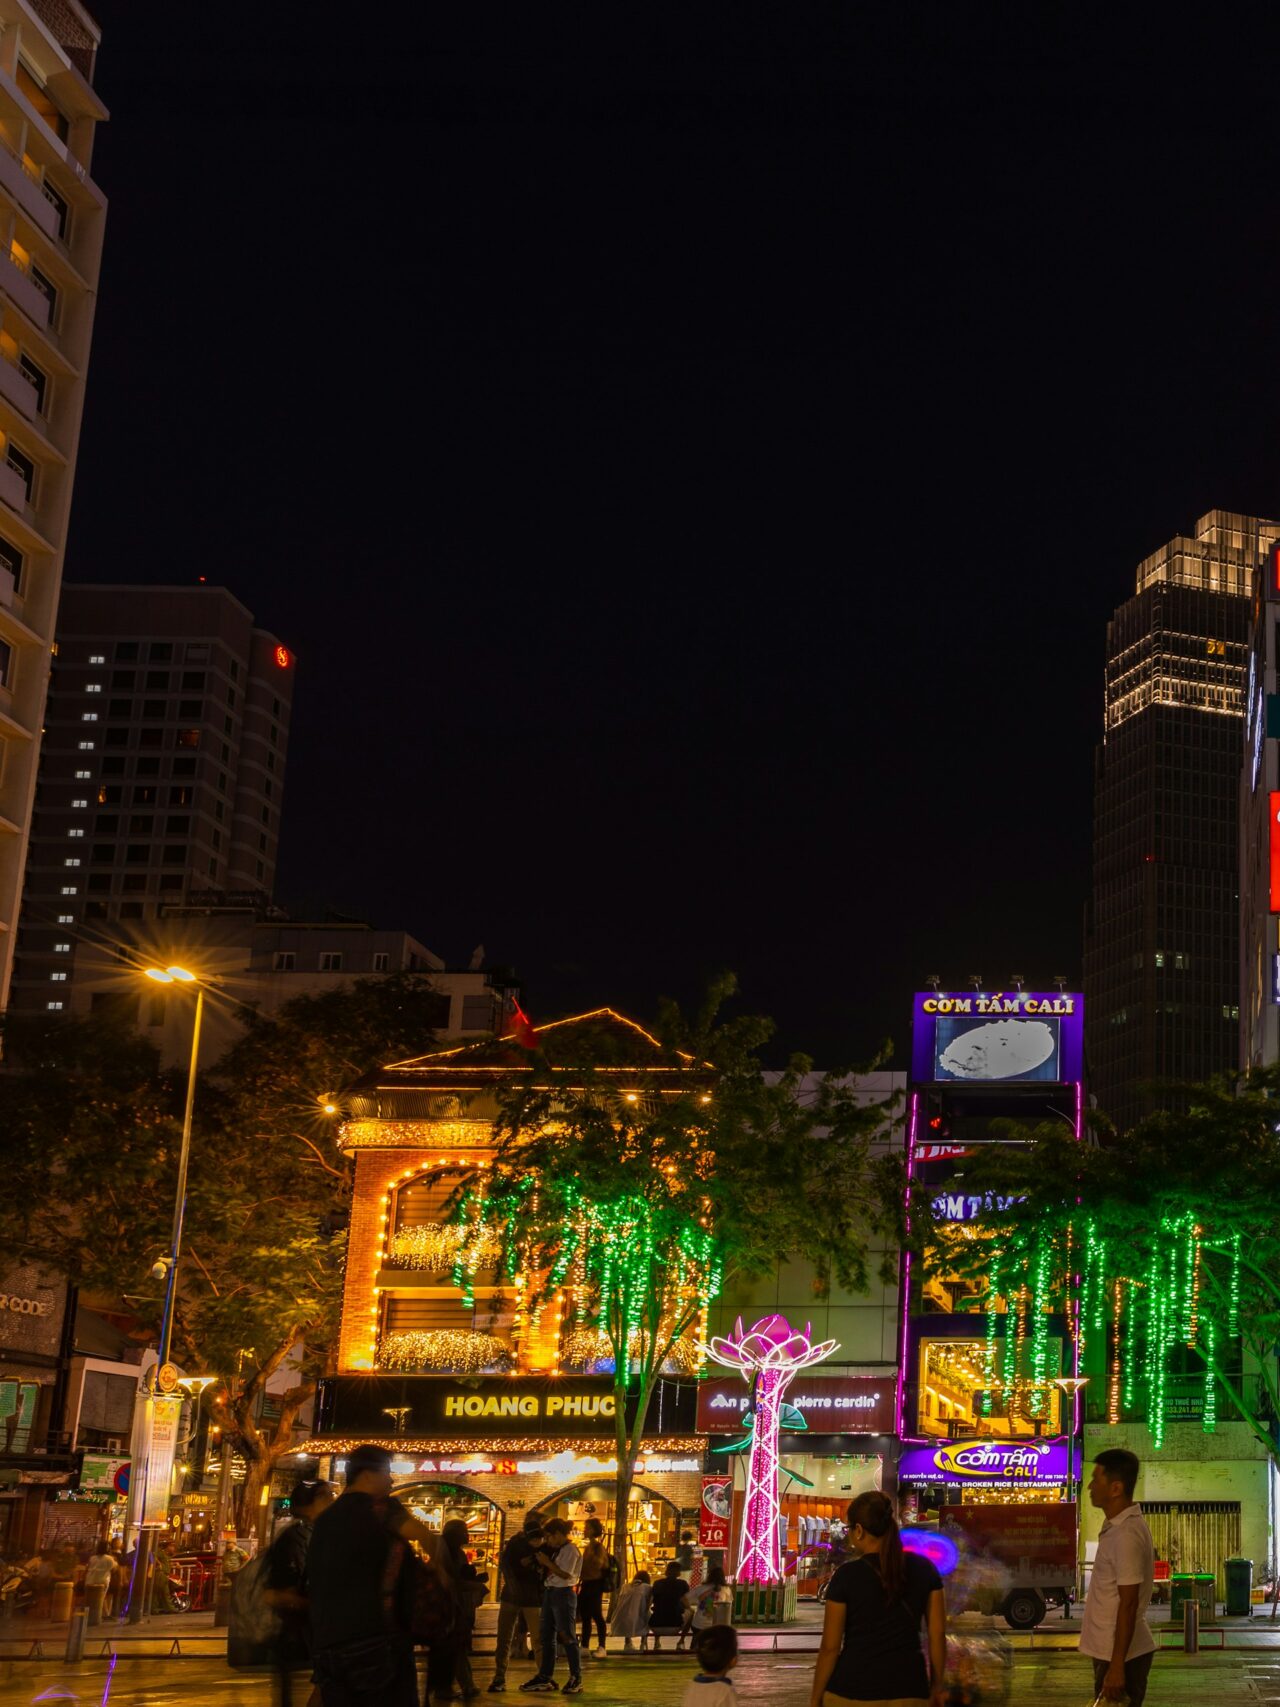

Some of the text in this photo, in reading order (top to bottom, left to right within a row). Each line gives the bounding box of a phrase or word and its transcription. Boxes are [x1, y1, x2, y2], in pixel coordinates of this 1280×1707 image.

[923, 993, 1075, 1014] CƠM TẤM CALI
[445, 1396, 616, 1417] HOANG PHUC
[794, 1394, 876, 1410] pierre cardin
[1003, 1466, 1038, 1478] CALI
